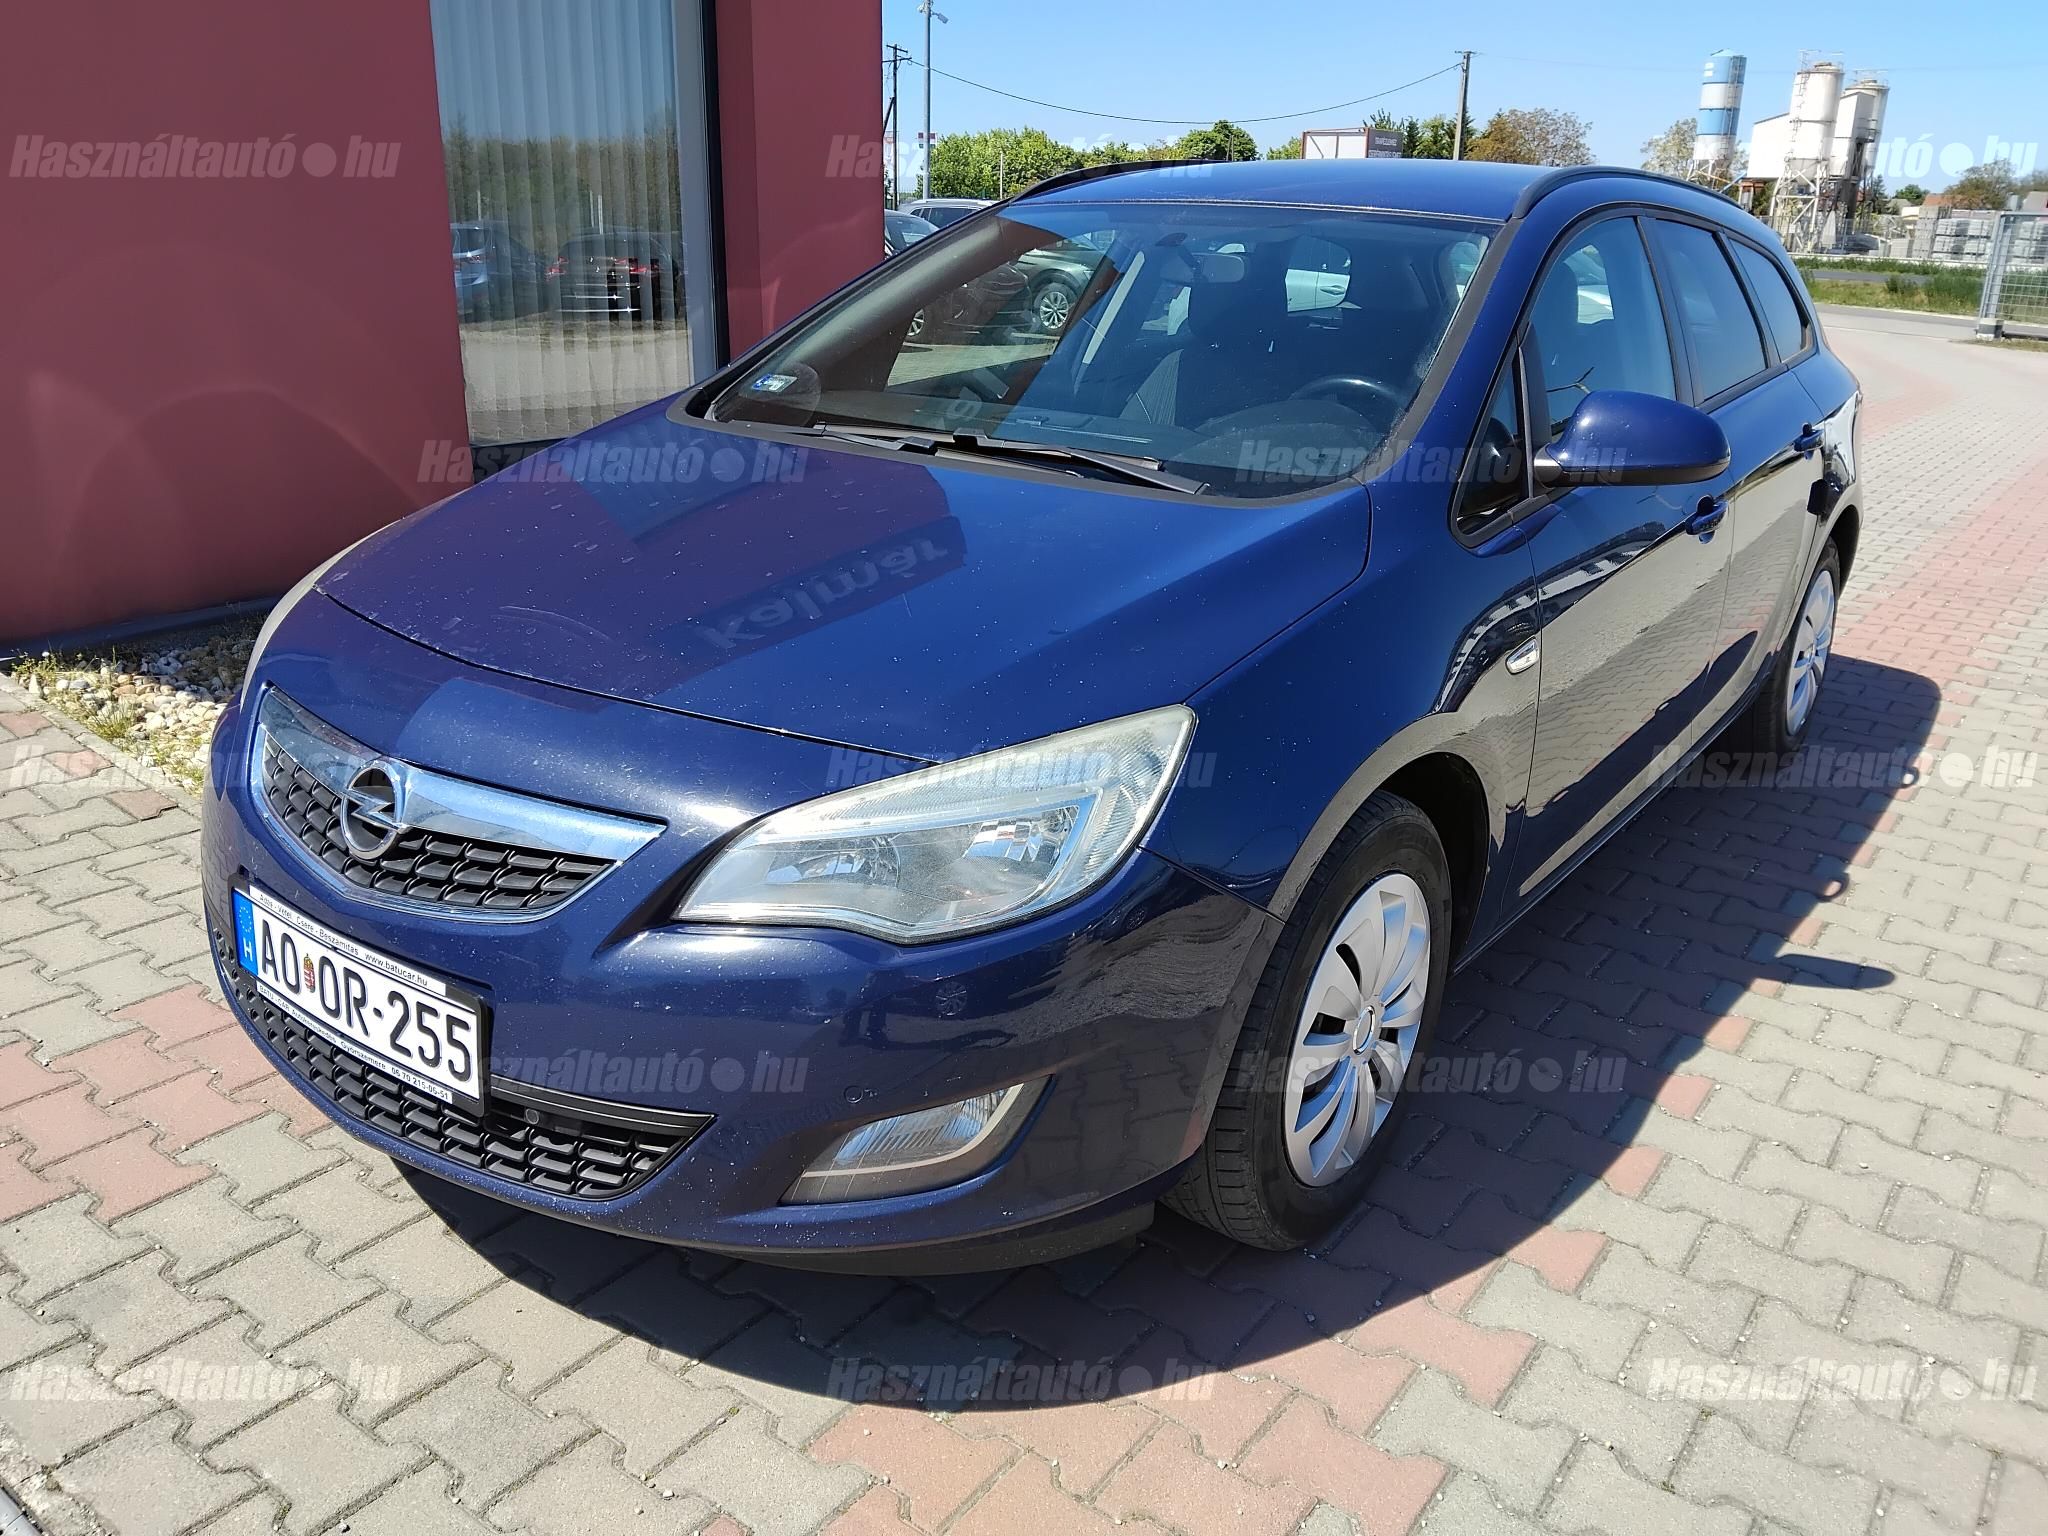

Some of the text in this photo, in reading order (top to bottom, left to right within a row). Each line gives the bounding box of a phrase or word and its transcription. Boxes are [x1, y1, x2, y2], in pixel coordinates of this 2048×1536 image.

[242, 936, 254, 962] H
[364, 952, 428, 986] www.batucar.hu
[261, 918, 472, 1083] AO OR-255
